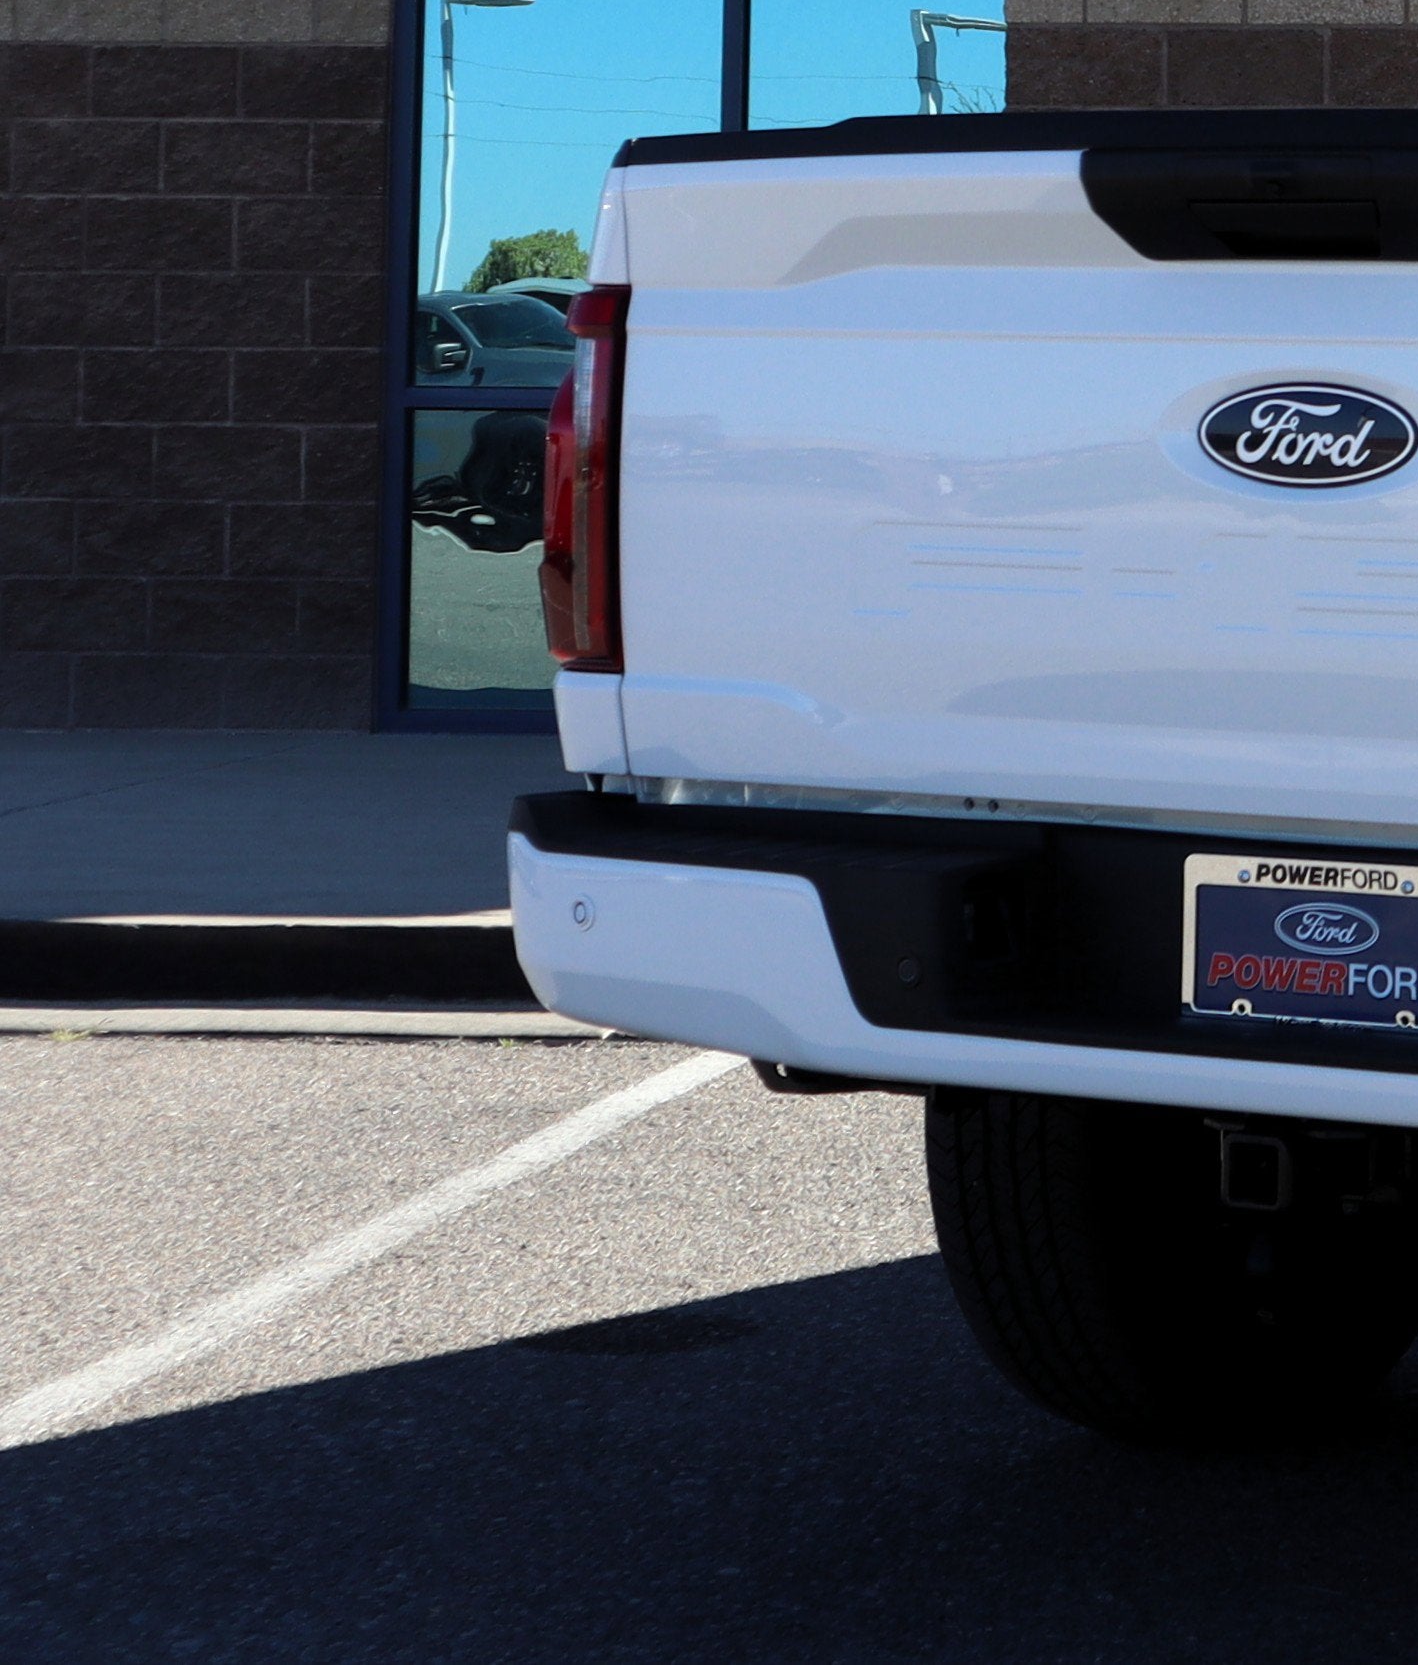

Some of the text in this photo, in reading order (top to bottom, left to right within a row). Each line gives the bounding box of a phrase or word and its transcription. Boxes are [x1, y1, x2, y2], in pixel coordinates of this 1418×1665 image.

[1235, 398, 1376, 468] Ford
[1255, 863, 1399, 891] POWERFORD
[1295, 911, 1357, 944] Ford
